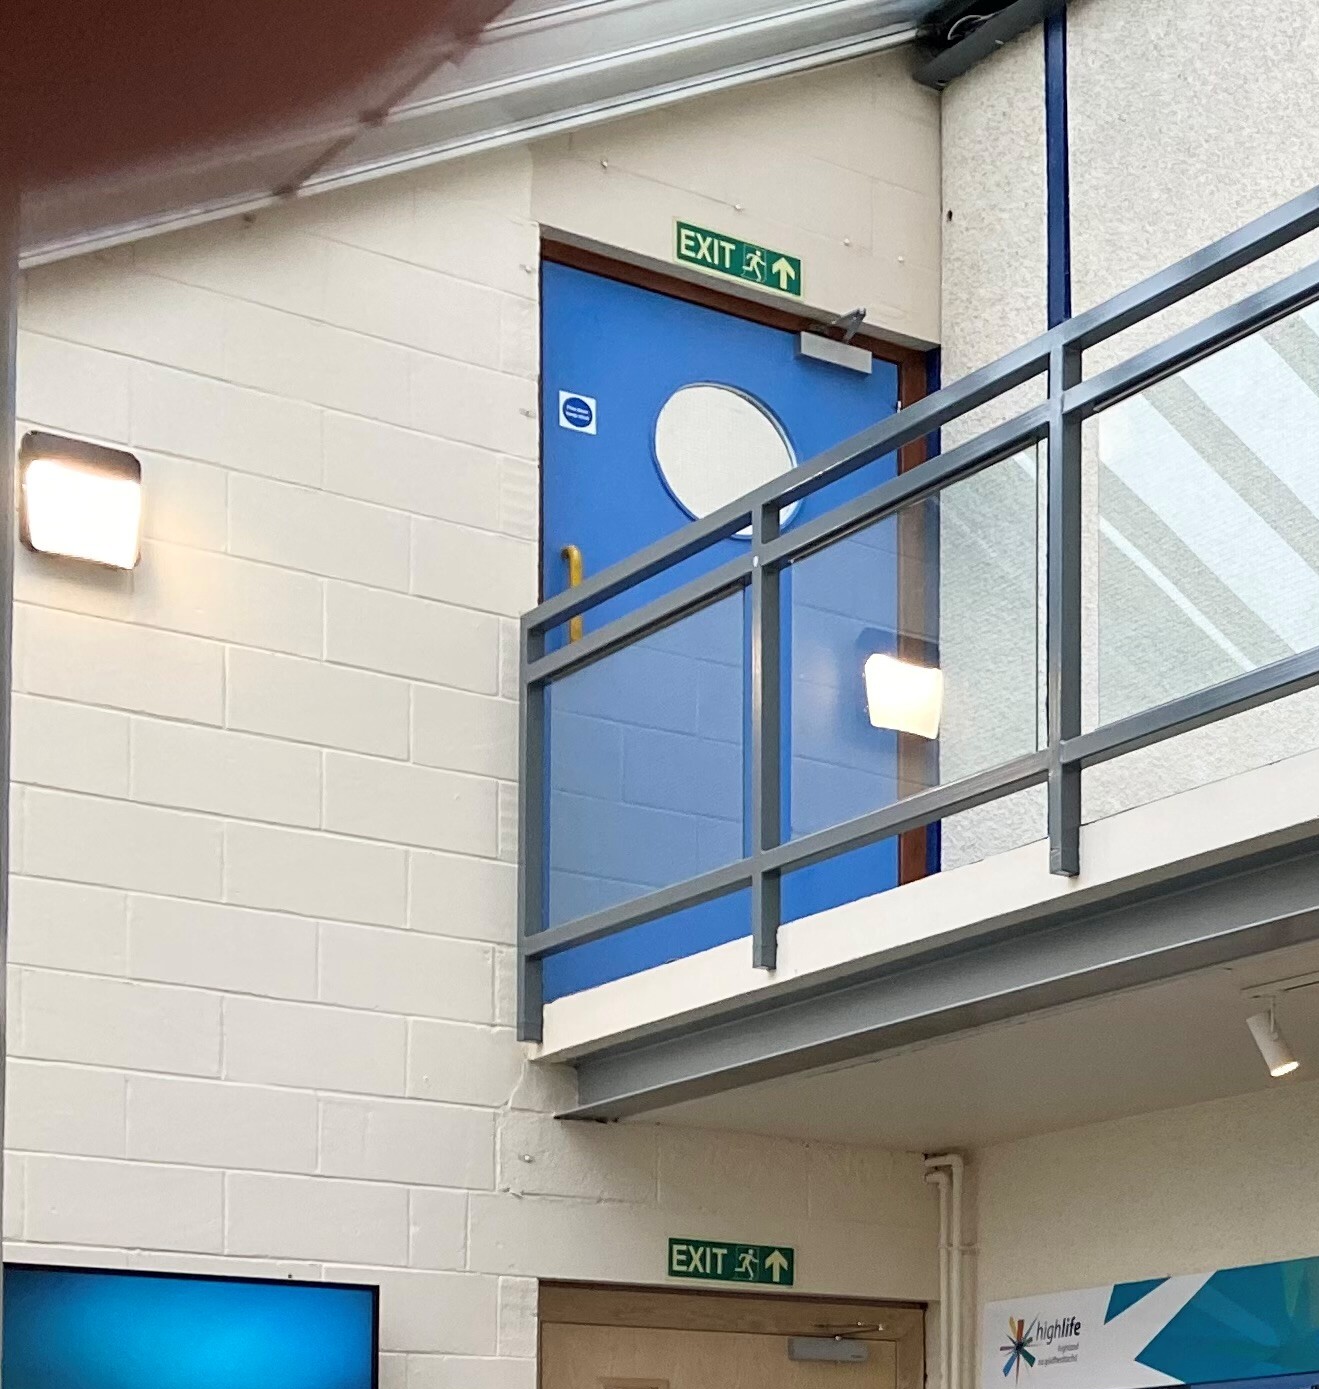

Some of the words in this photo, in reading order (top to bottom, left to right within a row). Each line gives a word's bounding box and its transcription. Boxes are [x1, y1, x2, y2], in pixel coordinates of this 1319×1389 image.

[680, 228, 735, 268] EXIT
[671, 1243, 728, 1275] EXIT
[1036, 1316, 1081, 1345] highlife
